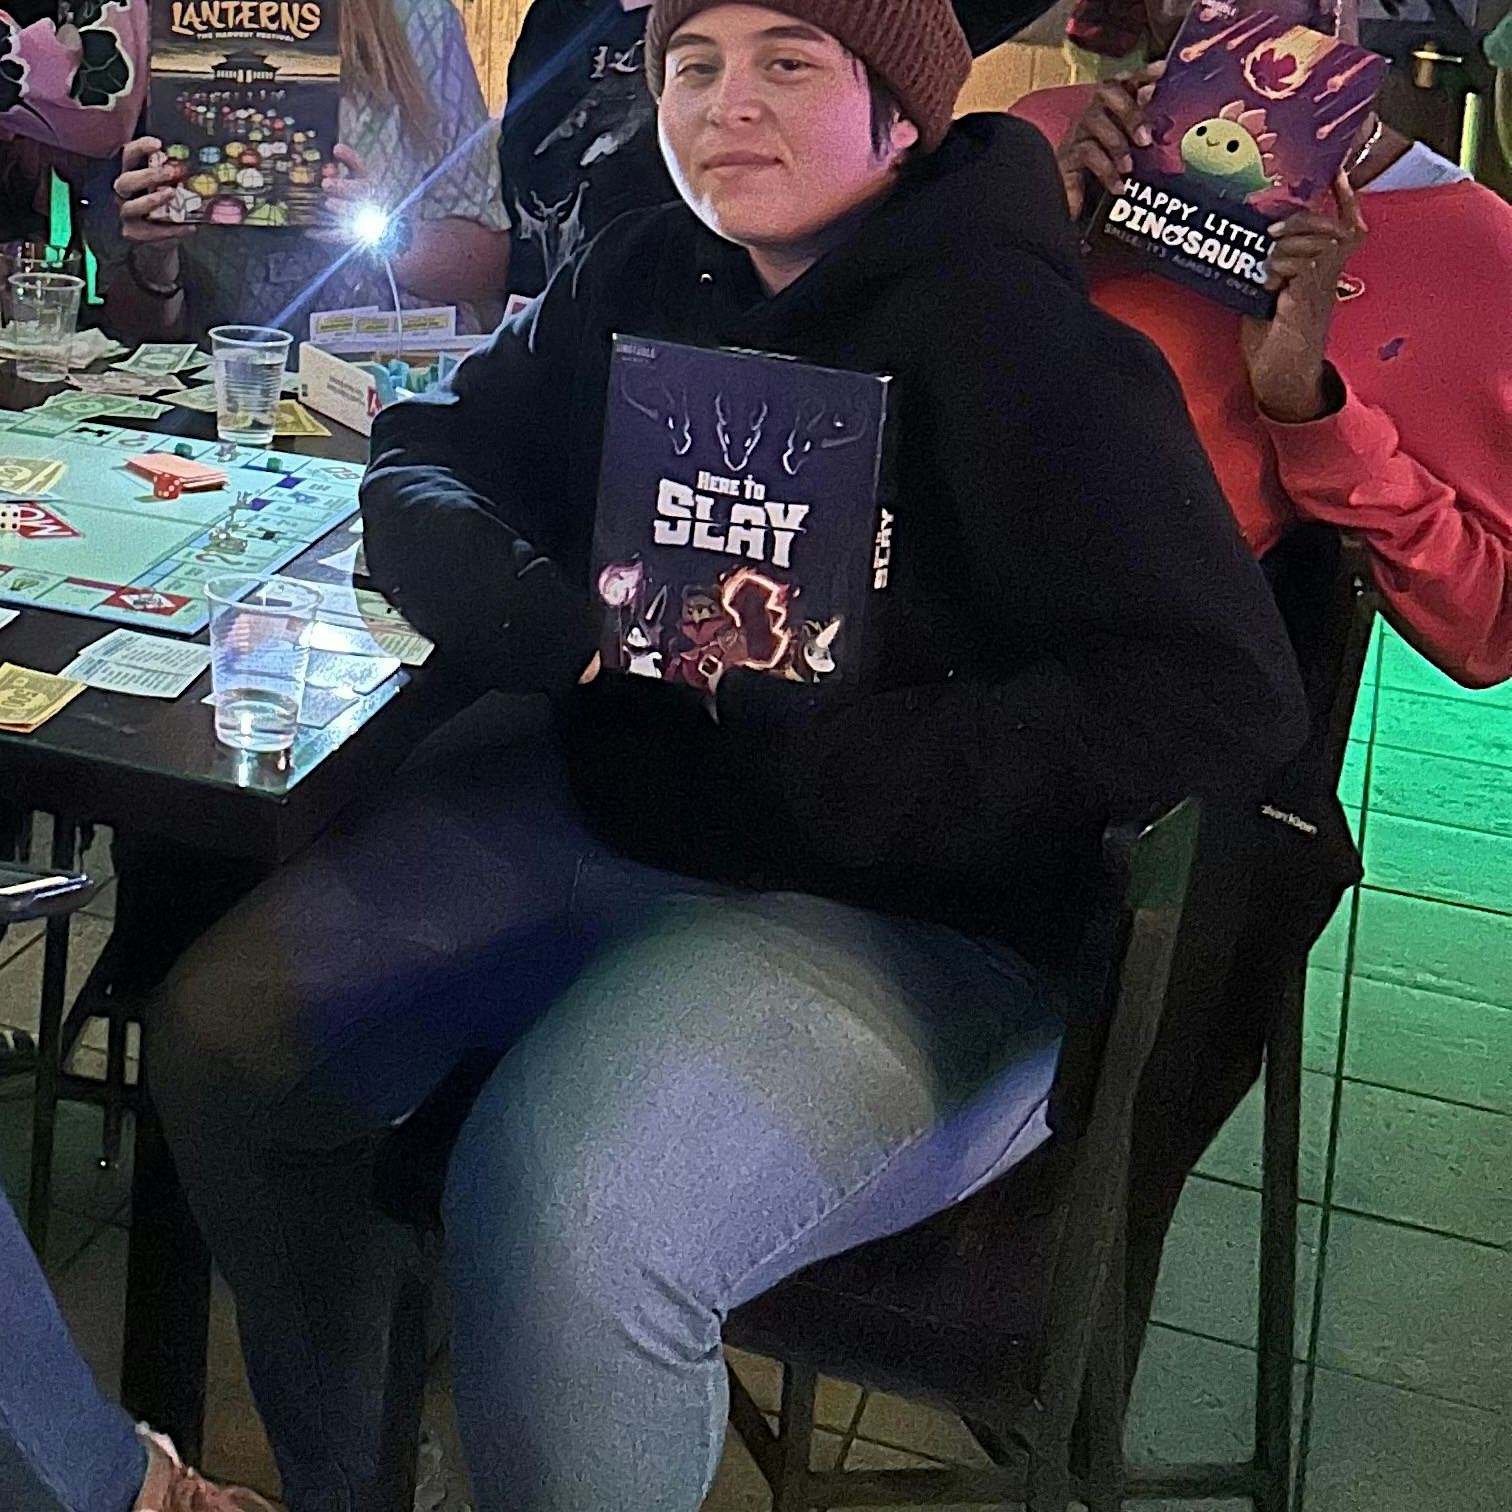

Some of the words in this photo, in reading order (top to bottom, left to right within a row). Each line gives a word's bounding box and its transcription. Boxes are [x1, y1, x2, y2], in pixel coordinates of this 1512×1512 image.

[171, 0, 321, 39] LANTERNS
[1123, 178, 1199, 221] HAPPY
[1108, 199, 1268, 285] DINOSAURS
[653, 478, 810, 568] SLAY
[1, 689, 40, 709] 500
